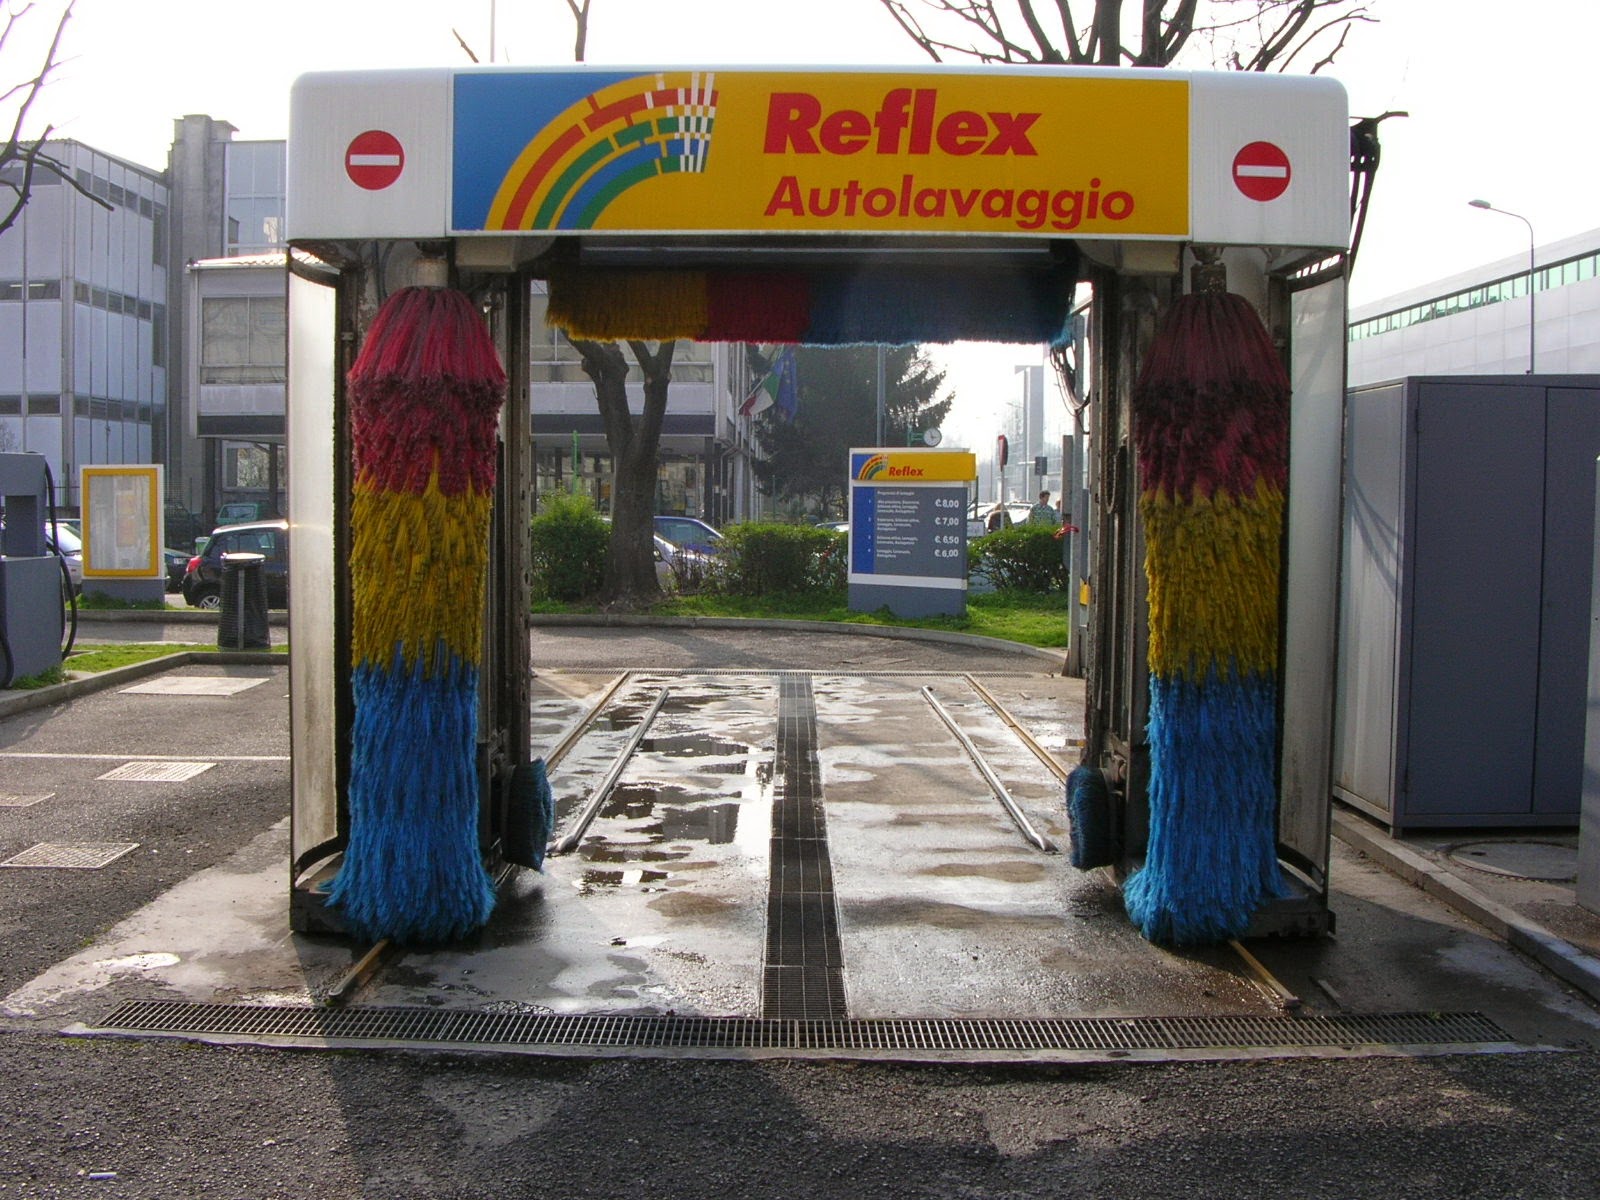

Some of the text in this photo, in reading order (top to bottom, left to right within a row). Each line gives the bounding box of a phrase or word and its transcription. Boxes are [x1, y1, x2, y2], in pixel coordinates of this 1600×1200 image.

[763, 88, 1042, 157] Reflex
[763, 174, 1136, 231] Autolavaggio
[889, 466, 924, 477] Reflex
[942, 498, 960, 508] 8,00
[942, 516, 960, 526] 7,00
[942, 535, 960, 544] 6,50
[942, 549, 959, 558] 6,00
